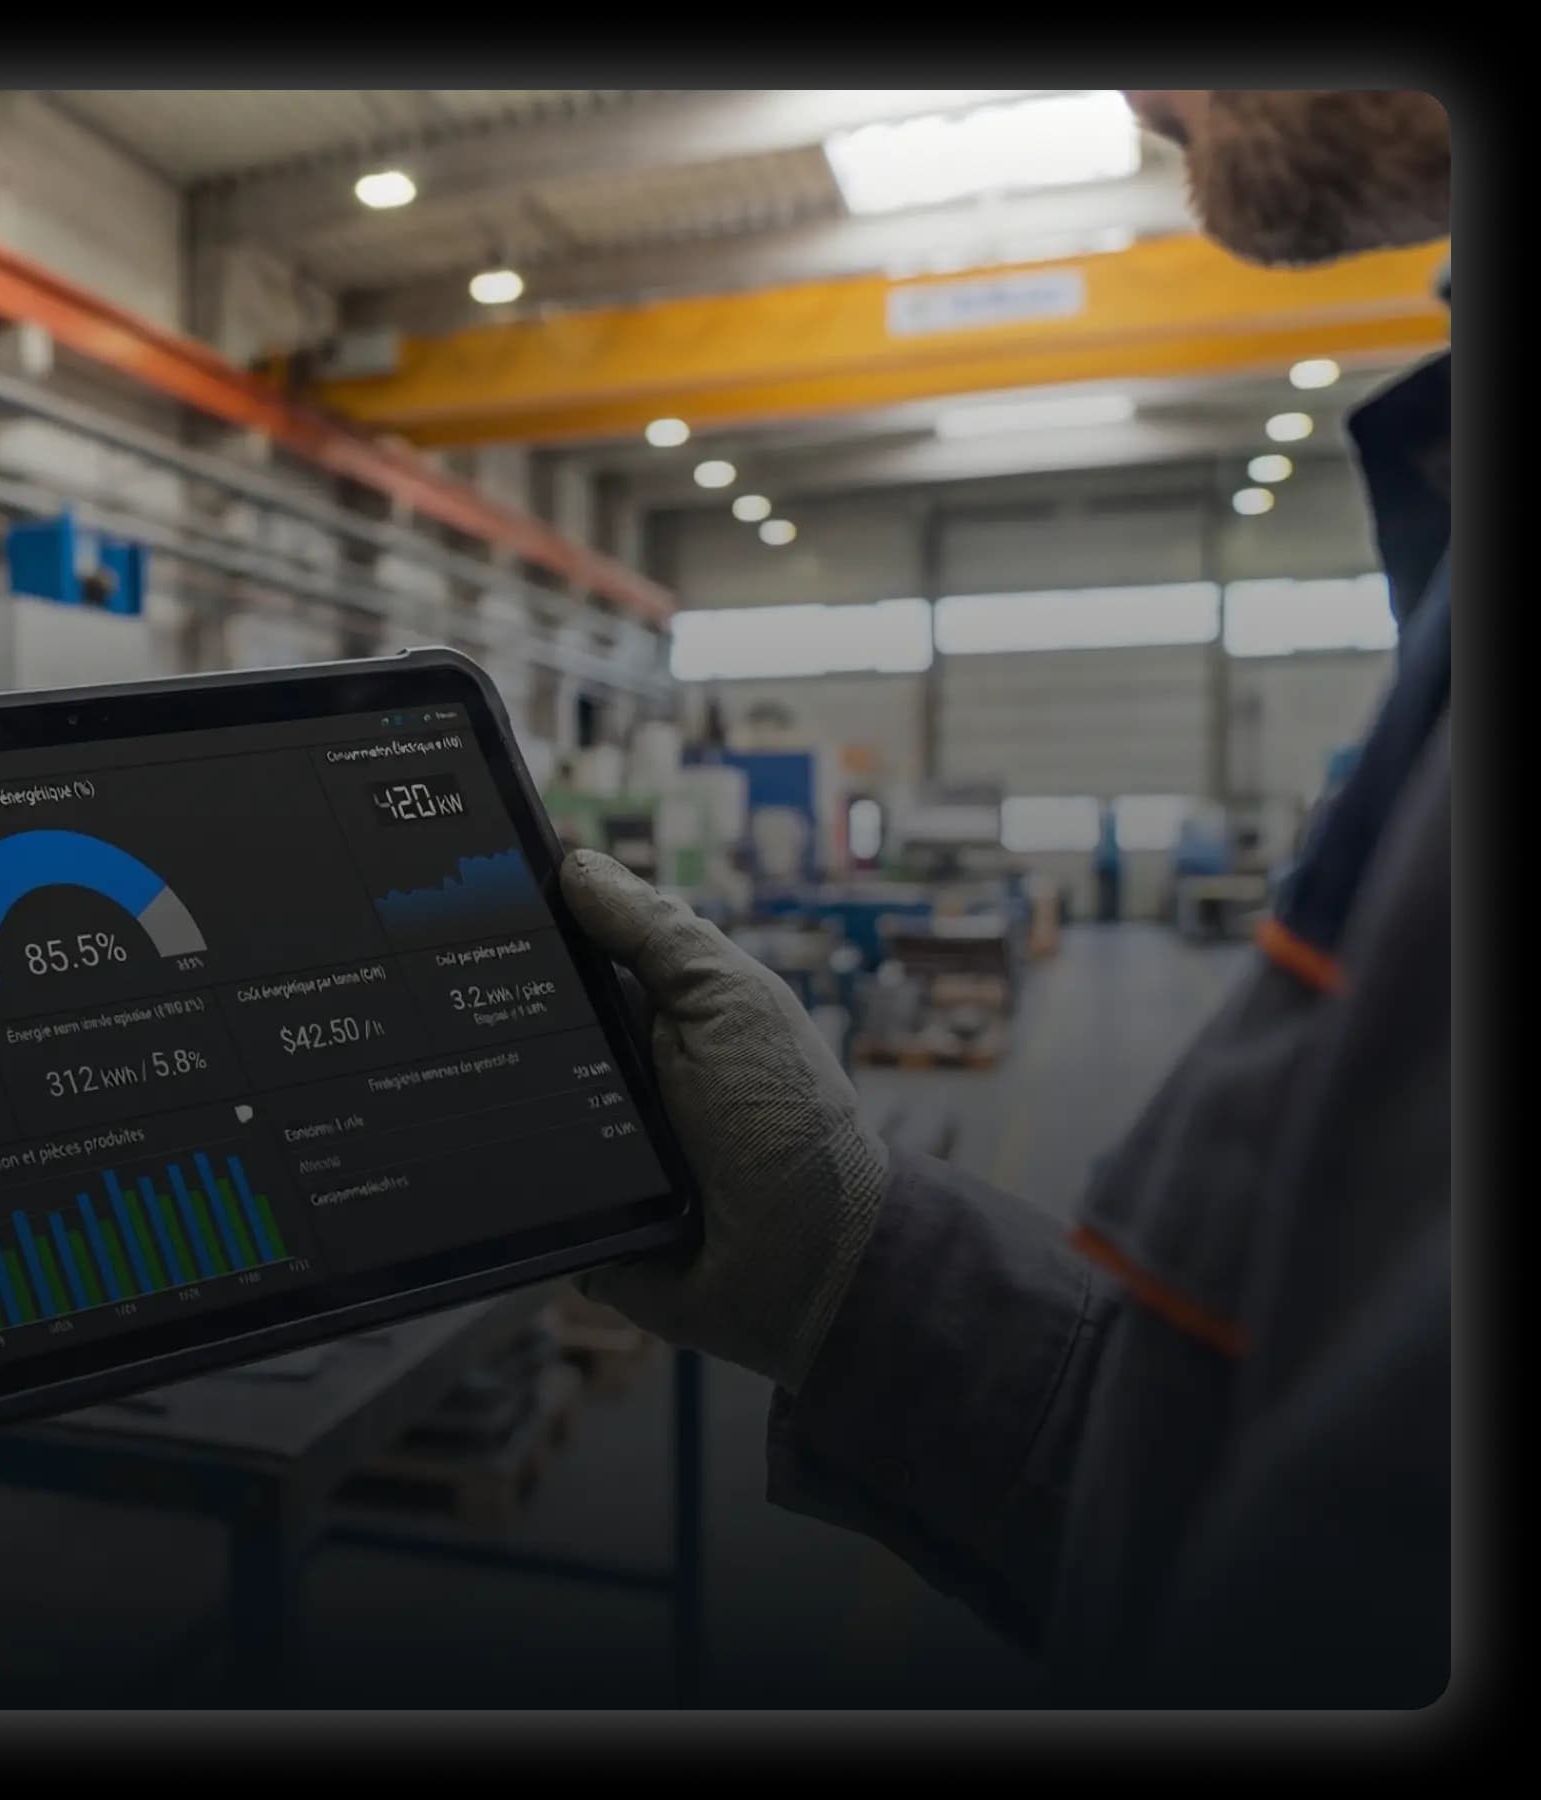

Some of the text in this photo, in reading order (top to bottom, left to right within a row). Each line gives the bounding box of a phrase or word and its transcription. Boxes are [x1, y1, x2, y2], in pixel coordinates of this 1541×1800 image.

[372, 783, 464, 820] 420 kW
[24, 931, 127, 976] 85.5%
[449, 985, 488, 1011] 3.2
[279, 1016, 359, 1056] $42.50
[45, 1065, 100, 1098] 312
[99, 1064, 139, 1090] kWh
[151, 1048, 208, 1078] 5.8%
[22, 1148, 36, 1166] et
[38, 1139, 82, 1167] pièces
[82, 1127, 146, 1156] produites
